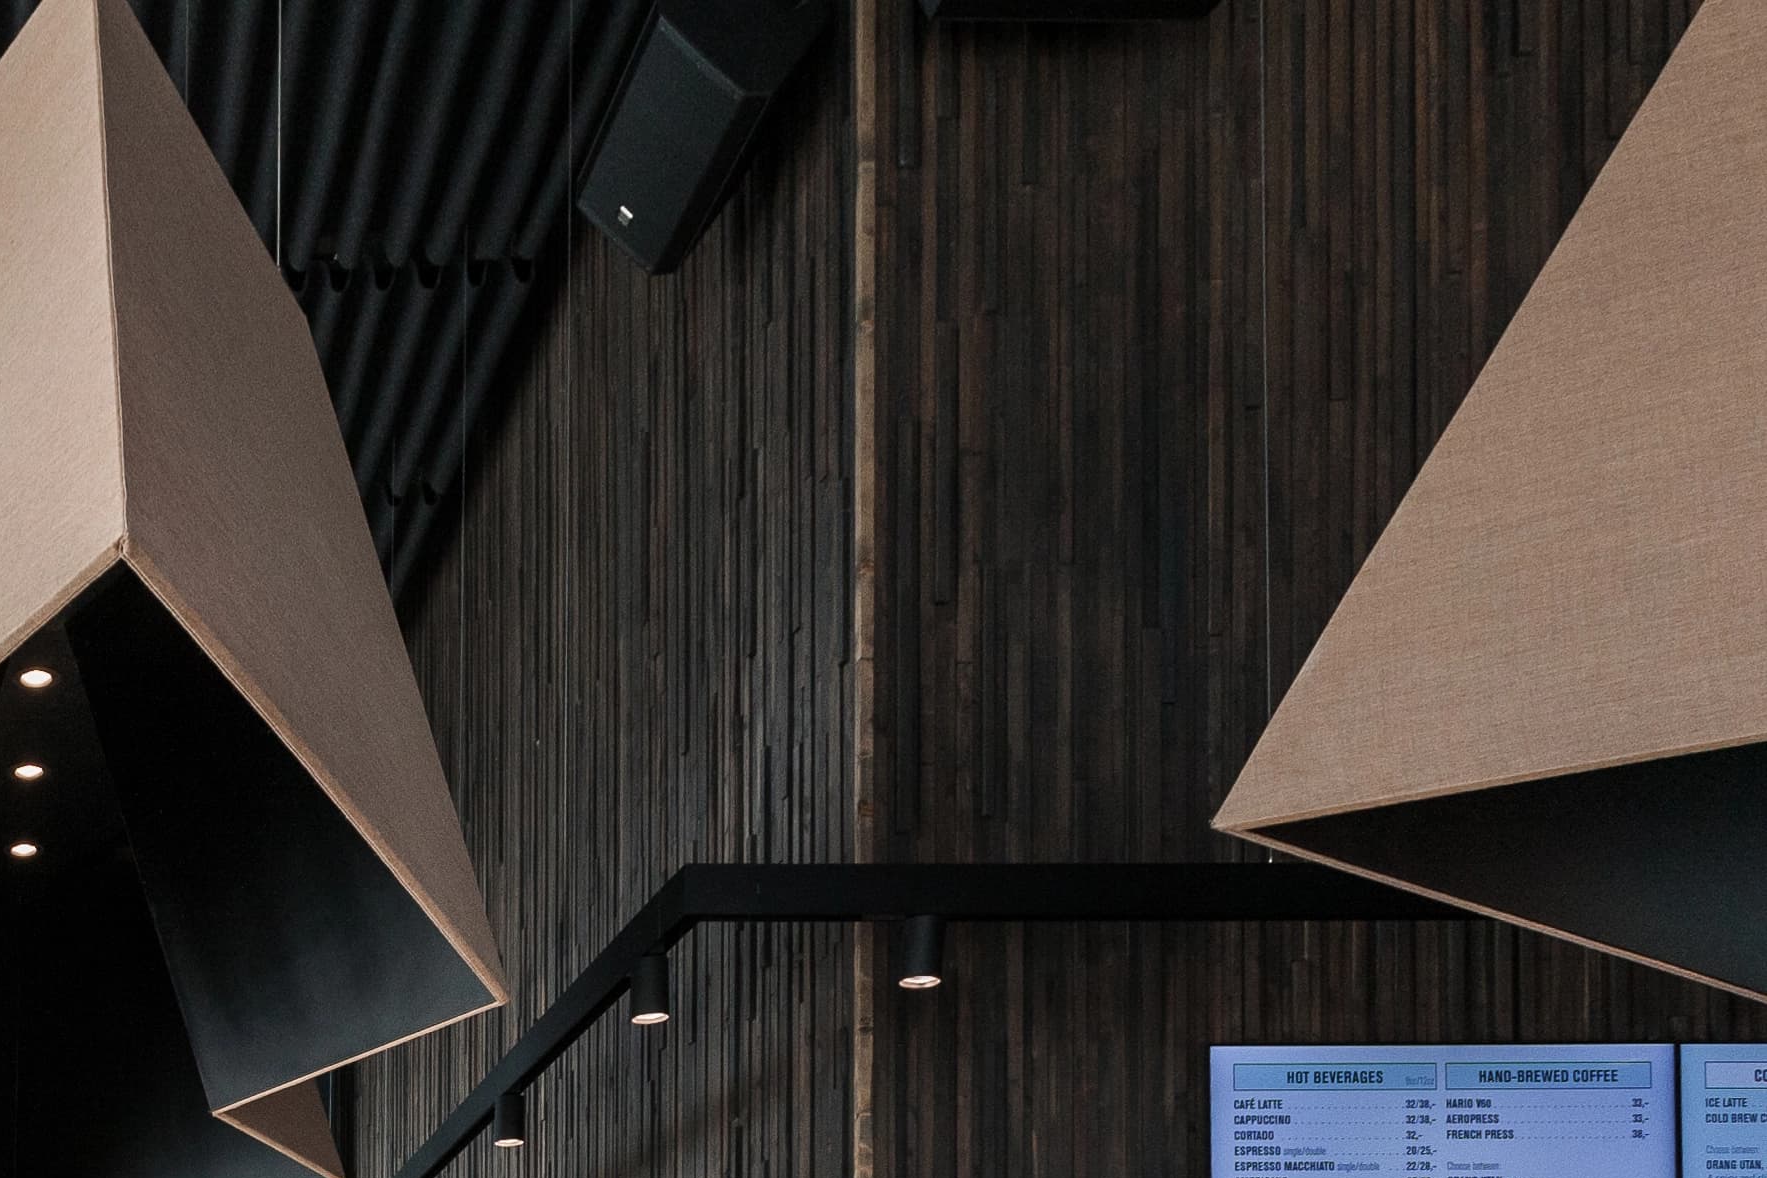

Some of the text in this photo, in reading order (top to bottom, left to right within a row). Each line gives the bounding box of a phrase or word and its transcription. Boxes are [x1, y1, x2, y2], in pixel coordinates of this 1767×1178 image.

[1287, 1071, 1383, 1083] HOT BEVERAGES
[1479, 1070, 1618, 1082] HAND-BREWED COFFEE
[1234, 1097, 1436, 1110] CAFÉ LATTE 32/38,-
[1446, 1099, 1473, 1108] HARIO
[1476, 1099, 1492, 1108] V60
[1706, 1098, 1748, 1107] ICE LATTE
[1234, 1115, 1291, 1125] CAPPUCCINO
[1446, 1115, 1499, 1124] AEROPRESS
[1706, 1114, 1728, 1123] COLD
[1731, 1114, 1758, 1123] BREW
[1234, 1131, 1423, 1140] CORTADO 32,-
[1447, 1130, 1481, 1139] FRENCH
[1485, 1130, 1514, 1139] PRESS
[1234, 1146, 1281, 1156] ESPRESSO
[1406, 1146, 1437, 1157] 20/25,-
[1235, 1162, 1281, 1171] ESPRESSO
[1284, 1162, 1335, 1171] MACCHIATO
[1706, 1161, 1764, 1170] ORANG UTAN,
